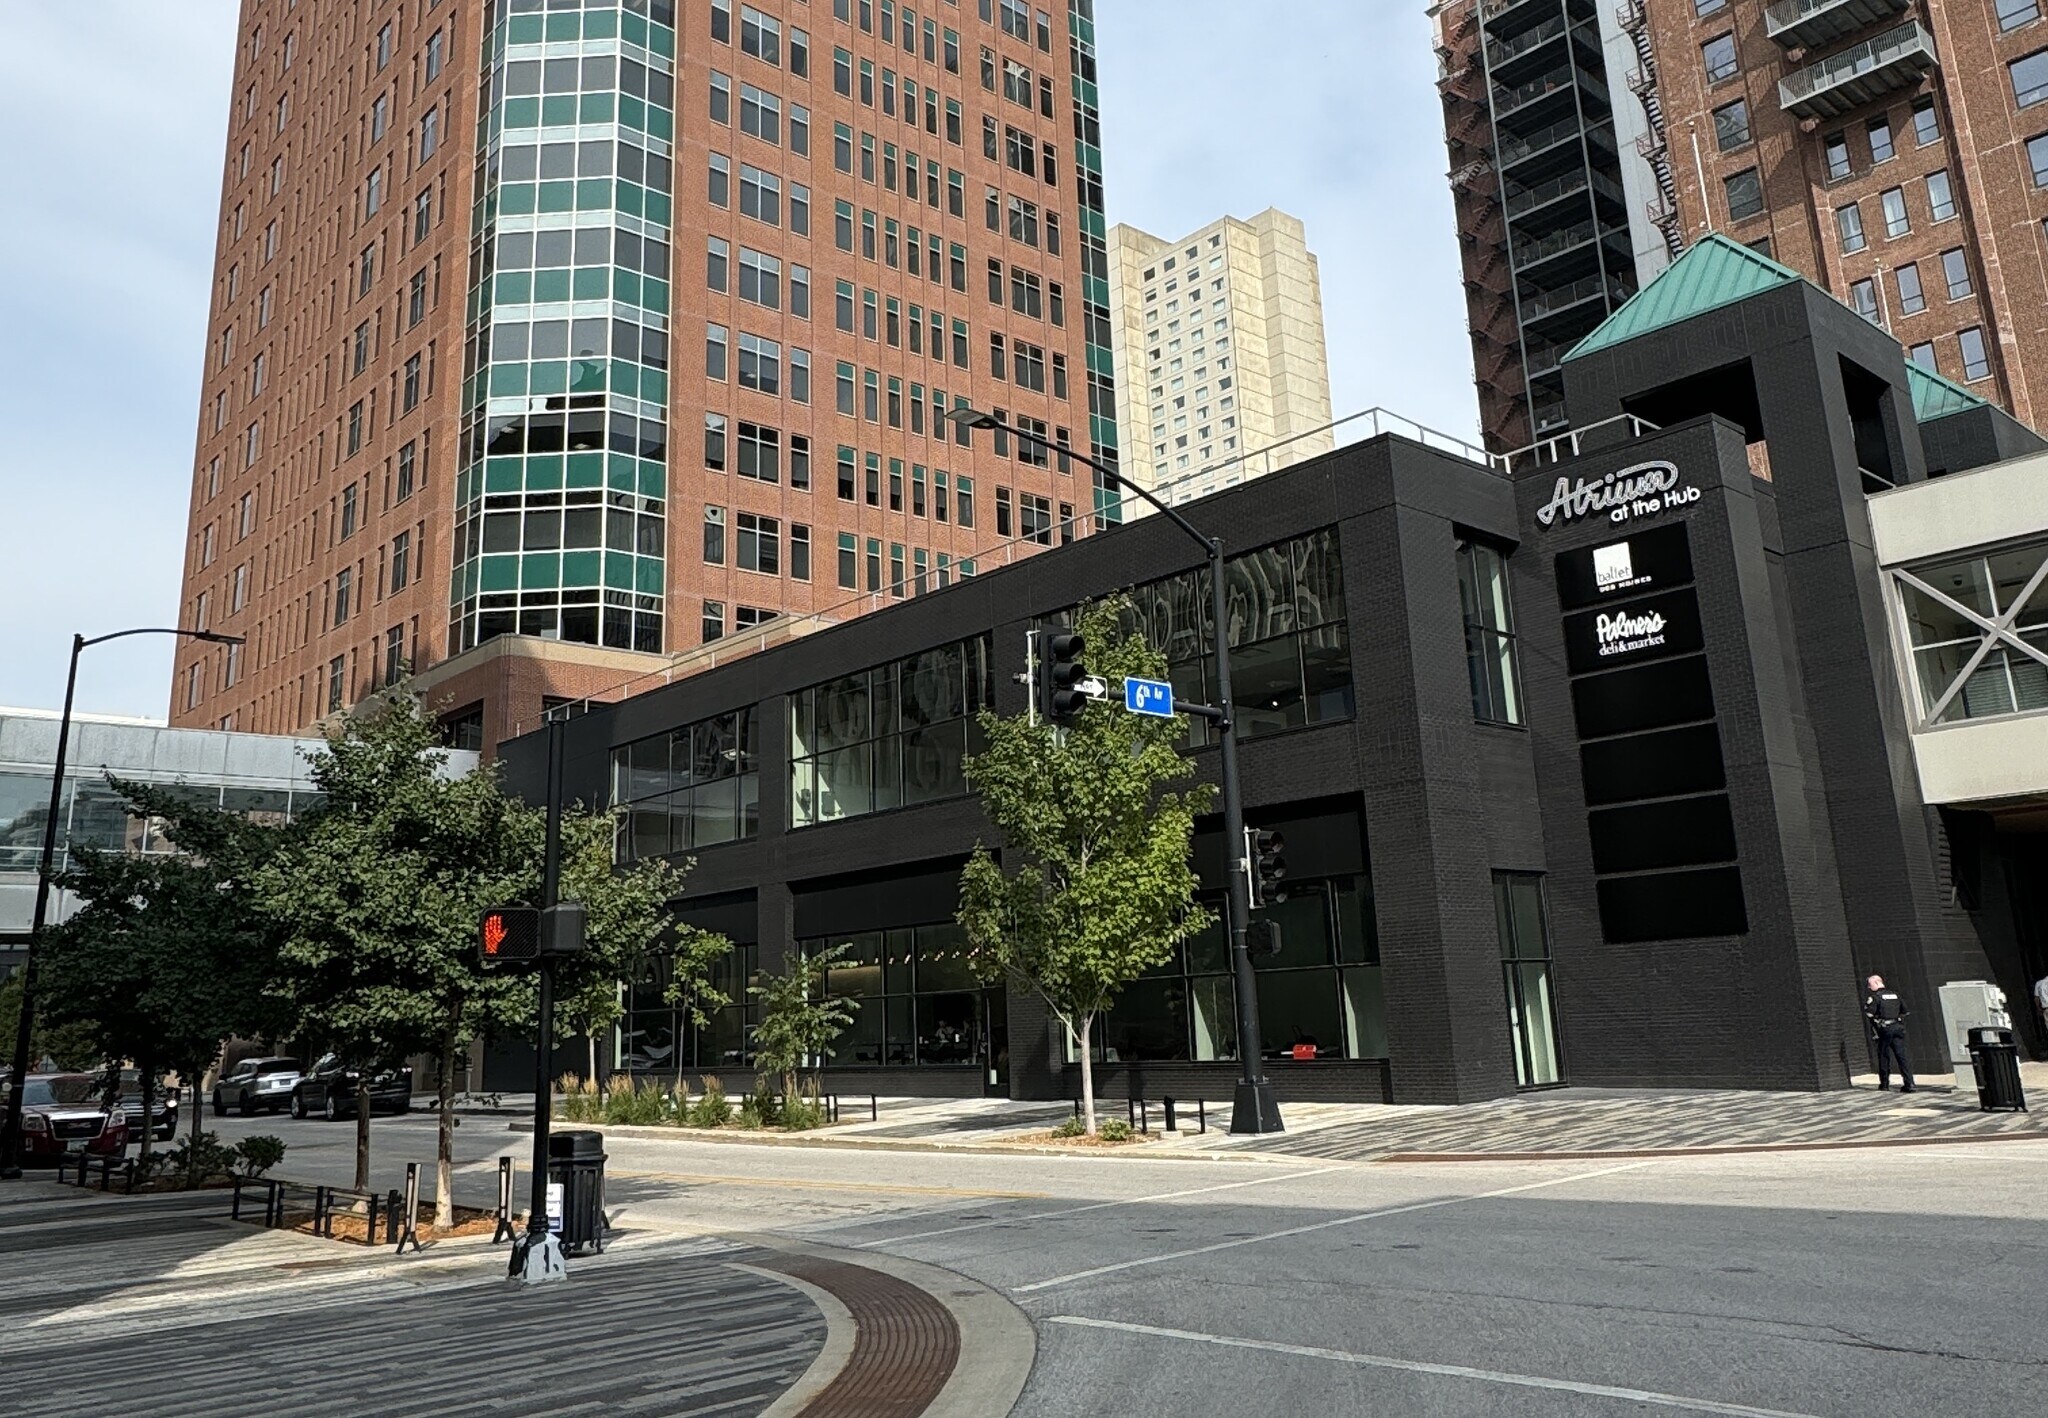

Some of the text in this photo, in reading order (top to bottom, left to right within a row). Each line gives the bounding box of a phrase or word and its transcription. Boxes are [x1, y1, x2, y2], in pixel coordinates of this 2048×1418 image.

[1537, 460, 1679, 524] Atrium
[1610, 486, 1701, 522] at the Hub
[1597, 566, 1630, 583] ballet
[1596, 610, 1668, 643] Palmer's
[1136, 684, 1151, 708] 6th
